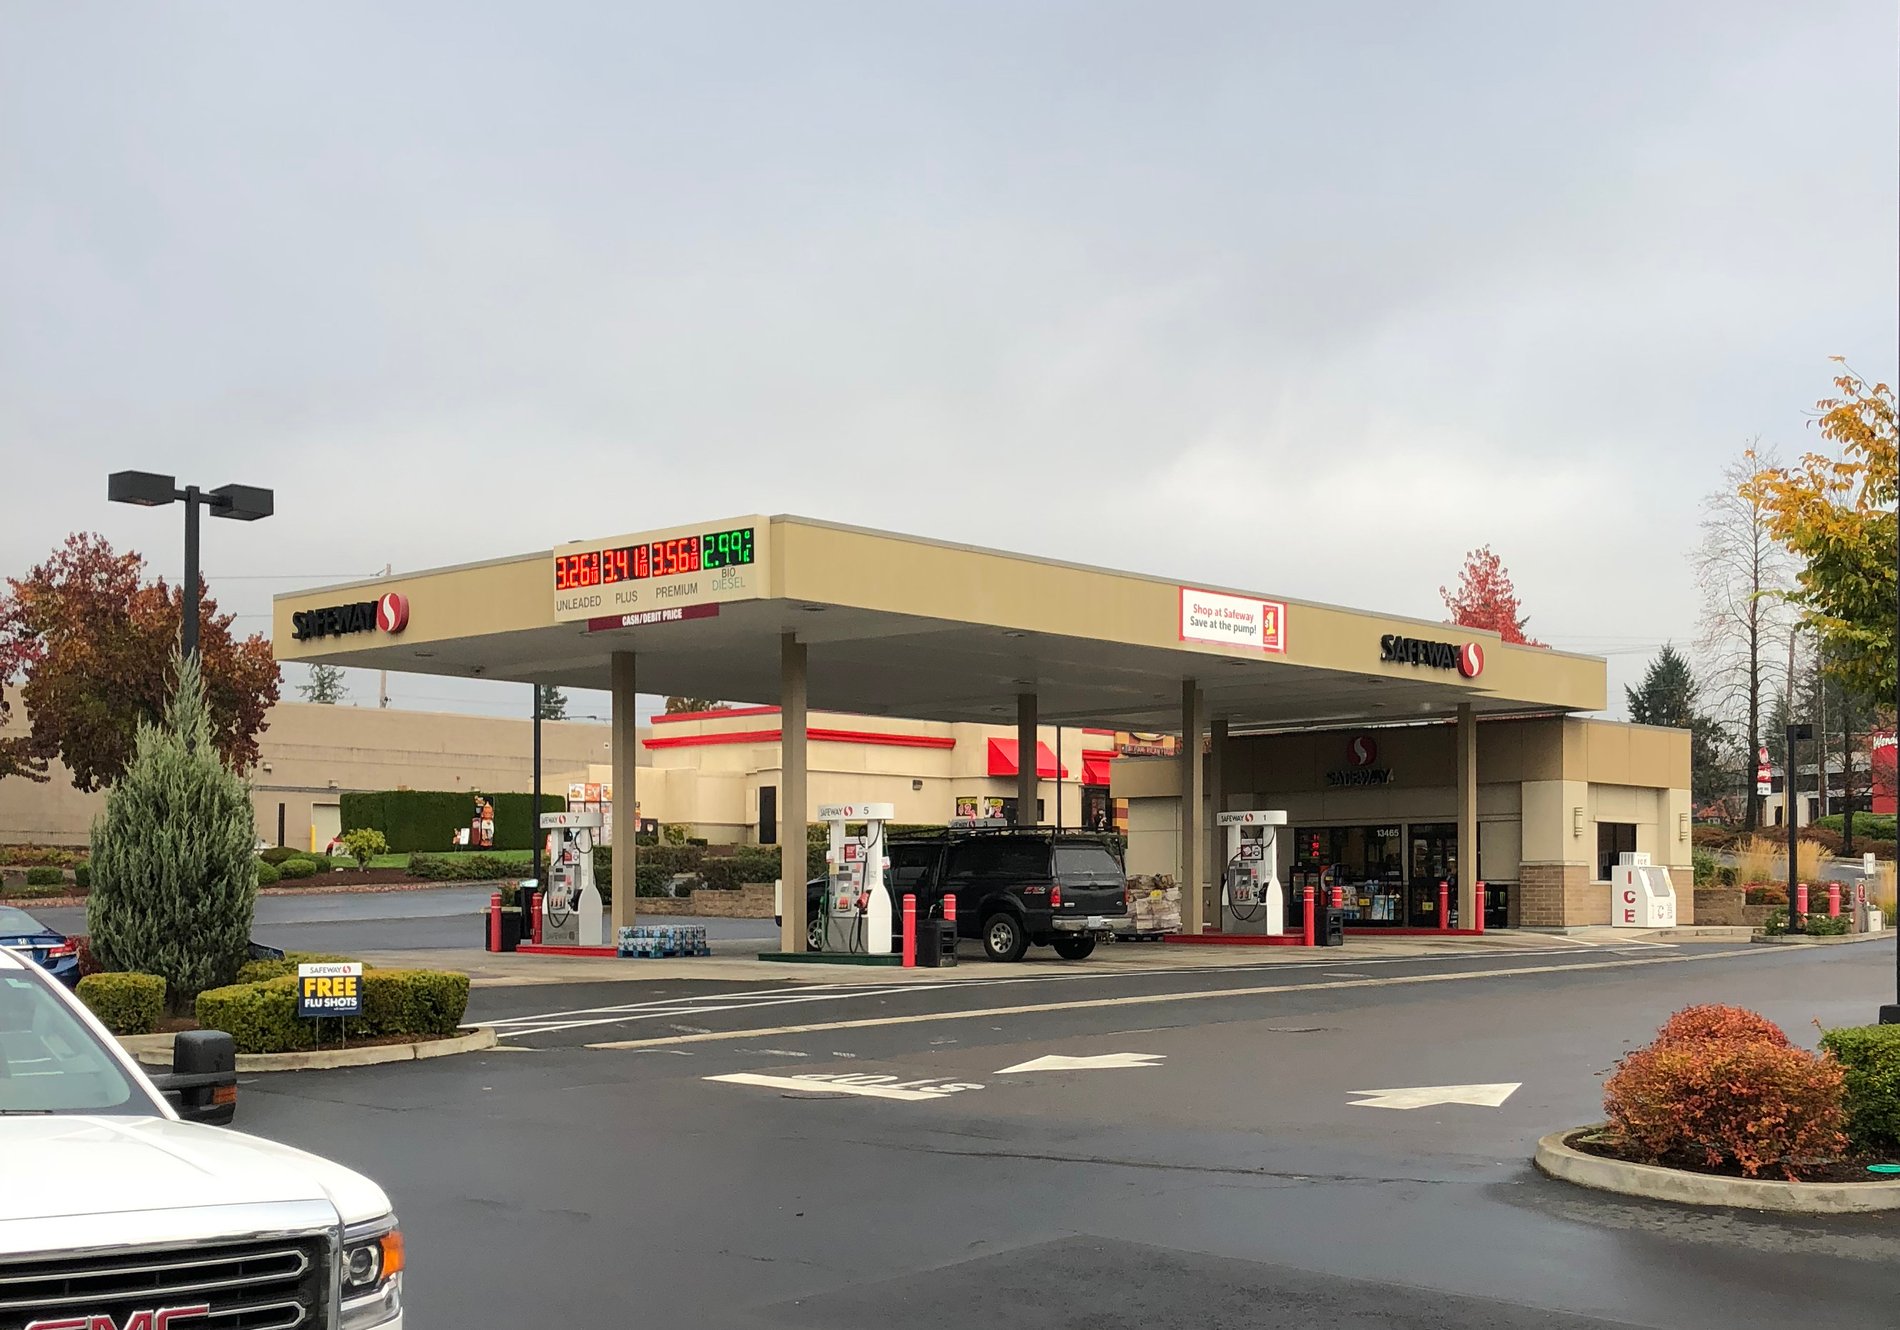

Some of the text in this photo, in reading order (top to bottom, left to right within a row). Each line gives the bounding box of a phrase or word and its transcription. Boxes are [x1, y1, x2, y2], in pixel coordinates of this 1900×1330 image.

[653, 539, 689, 575] 3.56
[705, 532, 741, 568] 2.99
[557, 555, 590, 588] 3.26
[604, 547, 639, 582] 3.41
[721, 567, 736, 579] BIO
[655, 583, 698, 599] PREMIUM
[712, 577, 746, 591] DIESEL
[556, 595, 602, 611] UNLEADED
[615, 590, 638, 605] PLUS
[292, 601, 379, 640] SAFEWAY
[622, 608, 682, 627] CASH/DEBIT PRICE
[1193, 603, 1254, 623] Shop at Safeway
[1190, 616, 1257, 636] Save at the pump!
[1264, 611, 1276, 635] $1
[1381, 634, 1461, 670] SAFEWAY
[1326, 768, 1392, 787] SAFEWAY
[820, 806, 869, 817] SAFEWAY 5
[1221, 814, 1244, 823] SAFEWAY
[1377, 829, 1399, 837] 13465
[1637, 858, 1648, 866] ICE
[1623, 871, 1636, 923] ICE
[310, 966, 341, 974] SAFEWAY
[304, 977, 357, 998] FREE
[304, 997, 357, 1008] FLU SHOTS
